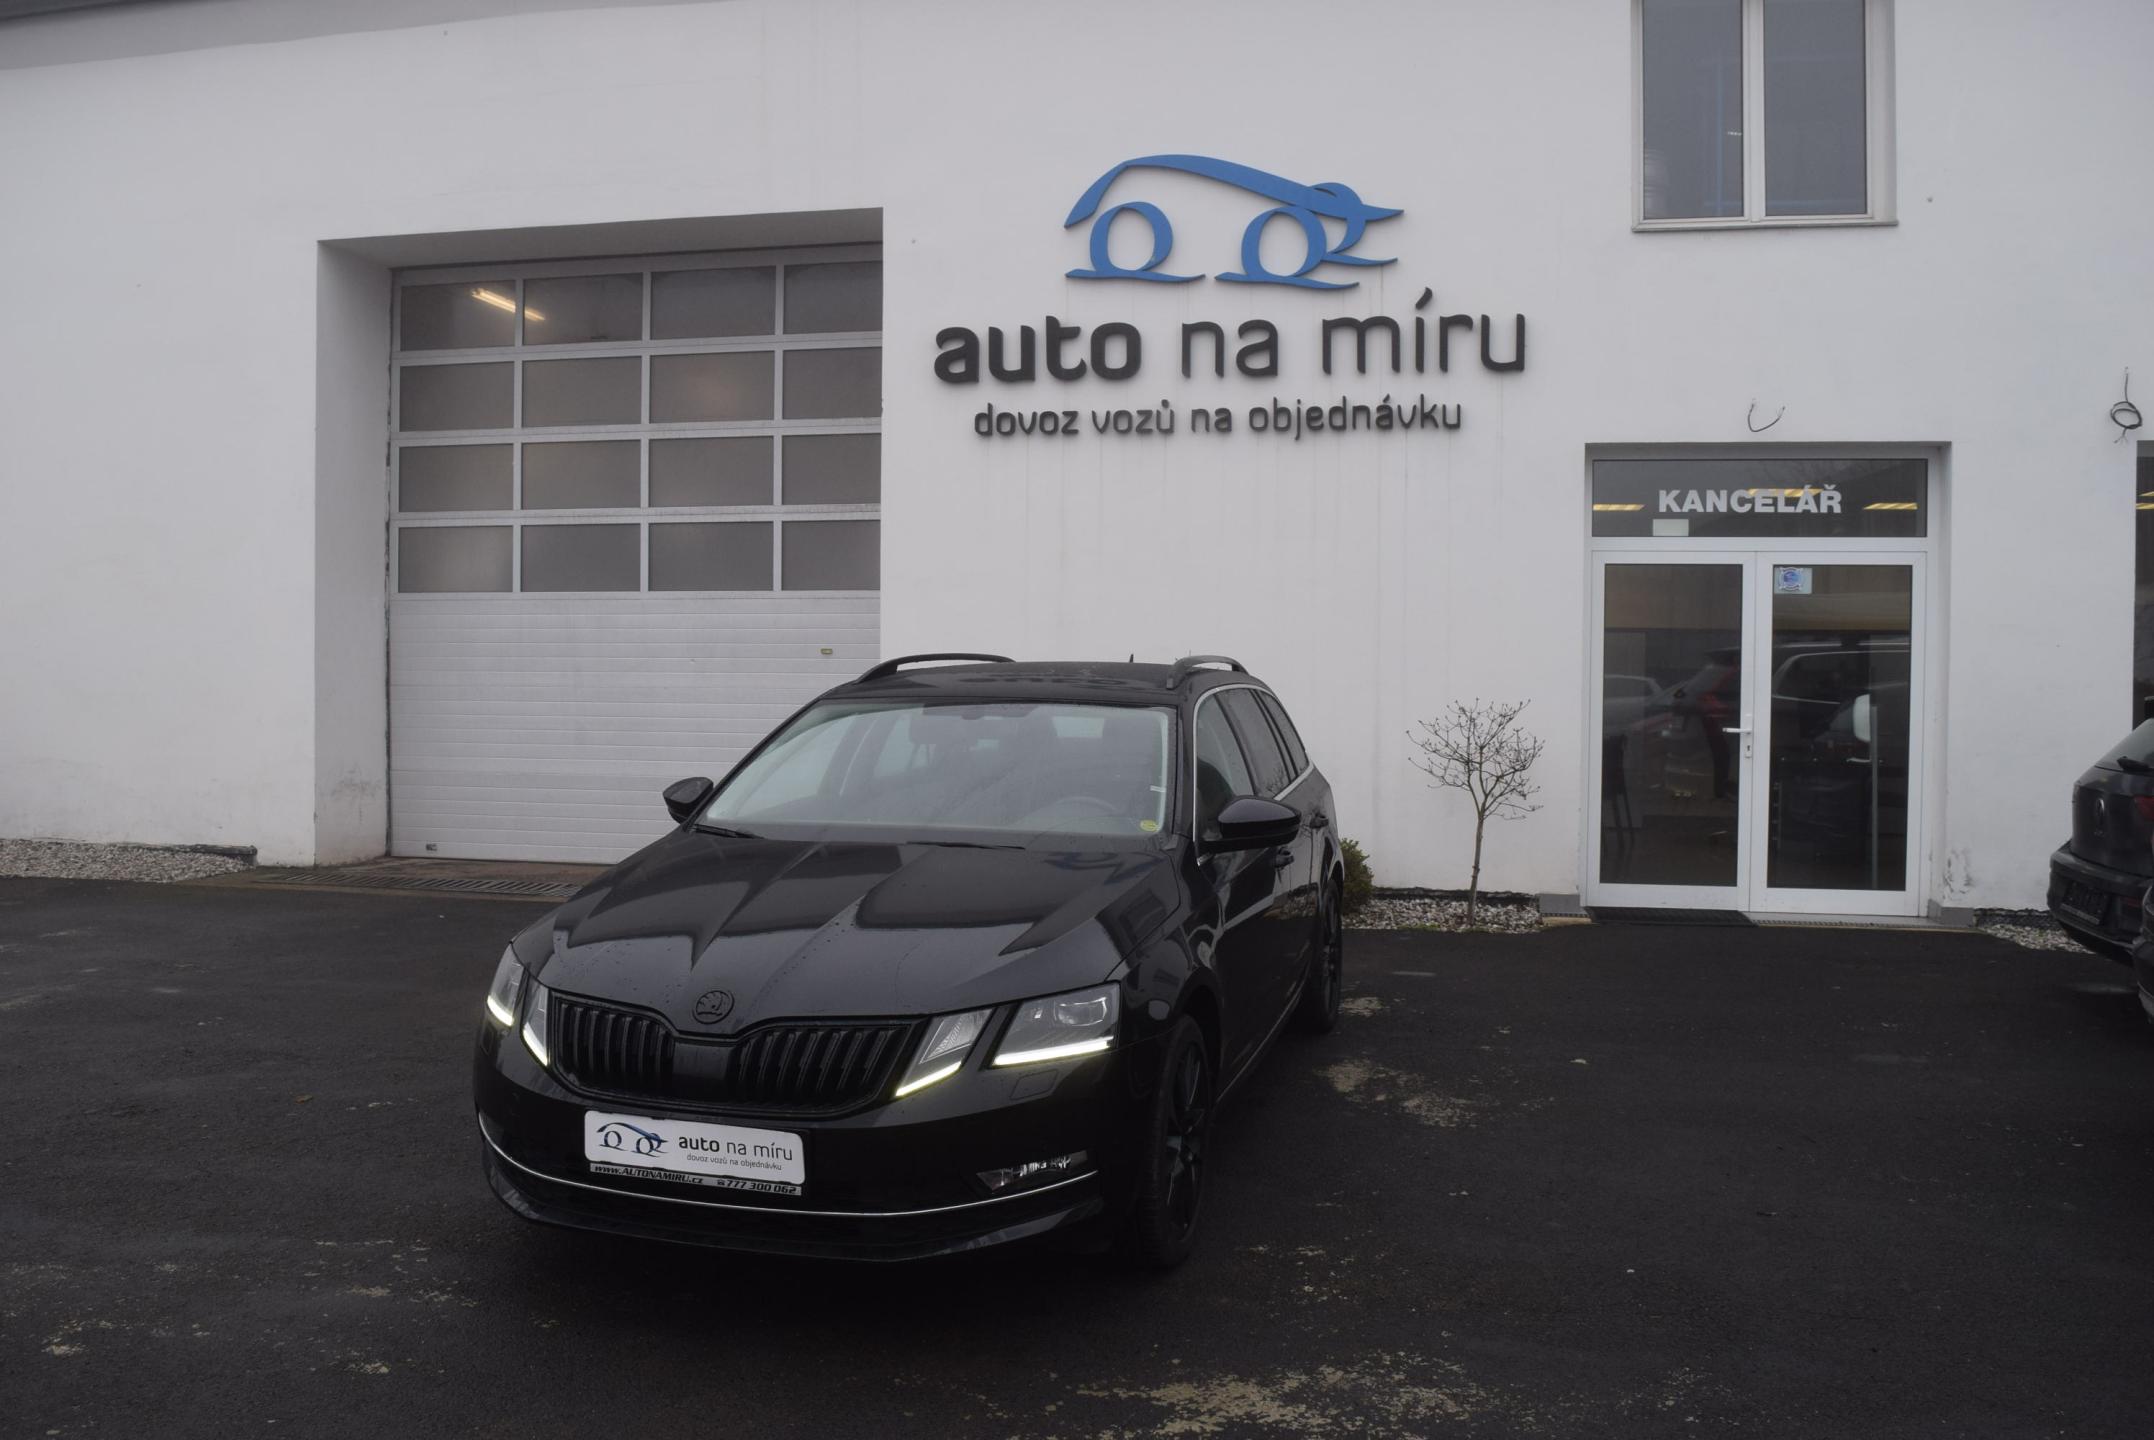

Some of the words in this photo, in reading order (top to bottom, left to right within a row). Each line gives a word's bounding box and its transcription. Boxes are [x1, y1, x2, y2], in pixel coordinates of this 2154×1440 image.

[934, 315, 1142, 383] auto
[1181, 317, 1279, 378] na
[1322, 287, 1526, 374] míru
[974, 403, 1080, 437] dovoz
[1091, 399, 1175, 435] vozů
[1191, 404, 1233, 432] na
[1248, 394, 1462, 441] objednávku
[1658, 484, 1842, 514] KANCELÁŘ
[678, 1136, 720, 1153] auto
[726, 1141, 747, 1155] na
[754, 1142, 793, 1161] míru
[686, 1153, 709, 1163] dovoz
[729, 1158, 739, 1166] na
[740, 1158, 782, 1171] objednávku
[727, 1179, 747, 1189] 777
[749, 1183, 771, 1192] 300
[774, 1185, 797, 1194] 062
